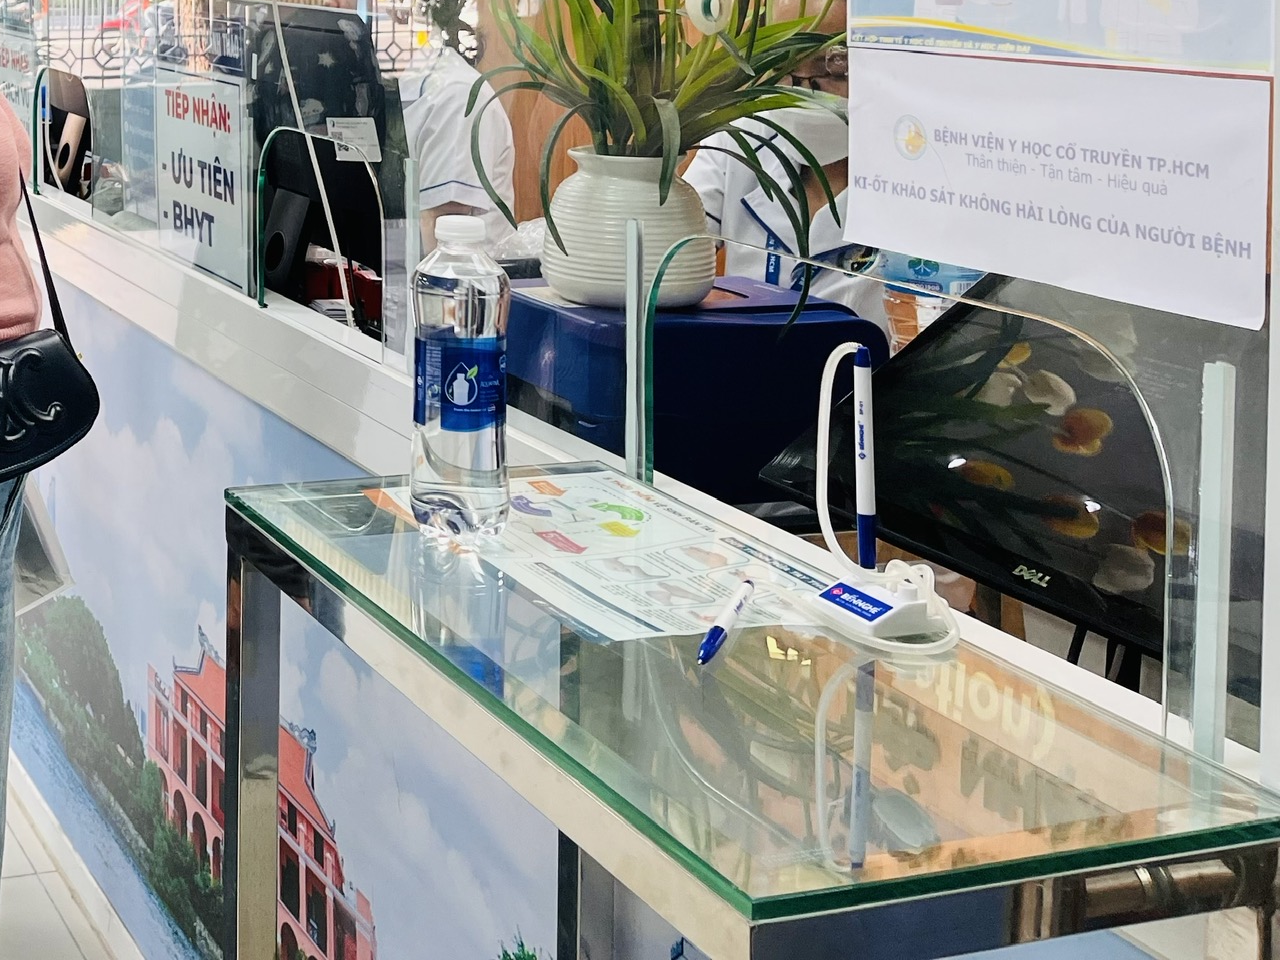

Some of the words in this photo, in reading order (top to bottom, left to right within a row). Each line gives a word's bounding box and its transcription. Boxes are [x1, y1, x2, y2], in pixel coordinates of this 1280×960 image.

[165, 86, 189, 121] TIẾP
[193, 93, 231, 138] NHẬN:
[172, 147, 193, 189] ƯU
[197, 156, 235, 206] TIÊN
[934, 126, 968, 148] BỆNH
[972, 130, 1005, 152] VIỆN
[1009, 139, 1018, 152] Y
[1021, 140, 1052, 162] HỌC
[1055, 142, 1077, 161] CỔ
[1079, 146, 1142, 170] TRUYỀN
[1147, 156, 1210, 179] TP.HCM
[965, 153, 994, 170] Thân
[997, 156, 1027, 176] thiện
[1040, 161, 1064, 182] Tận
[1068, 167, 1093, 185] tâm
[1107, 172, 1138, 192] Hiệu
[1141, 178, 1168, 197] quả
[173, 200, 215, 248] BHYT
[853, 170, 889, 192] KI-ỐT
[891, 178, 927, 200] KHẢO
[929, 181, 955, 206] SÁT
[959, 188, 1012, 217] KHÔNG
[1015, 195, 1044, 222] HÀI
[1048, 201, 1092, 231] LÒNG
[1096, 212, 1130, 237] CỦA
[1135, 219, 1196, 250] NGƯỜI
[1201, 232, 1252, 260] BỆNH
[1012, 564, 1052, 588] DELL
